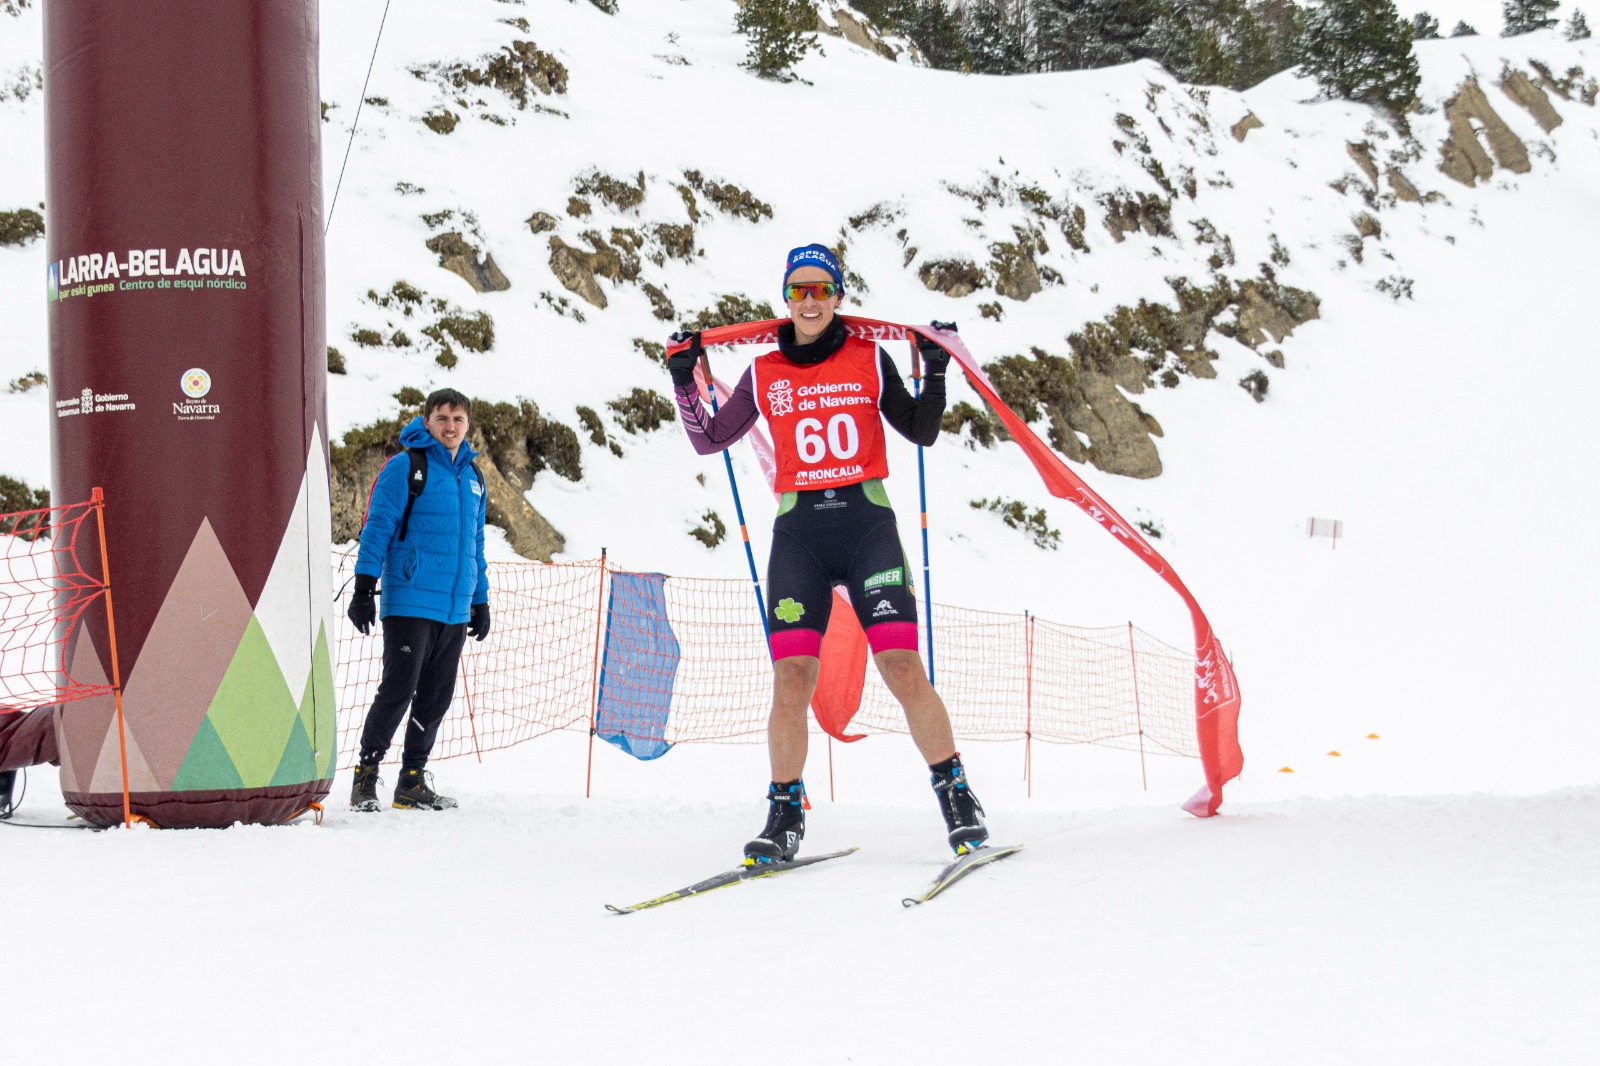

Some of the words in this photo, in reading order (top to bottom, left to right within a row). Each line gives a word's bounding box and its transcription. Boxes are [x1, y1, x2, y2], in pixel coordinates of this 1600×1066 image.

[59, 248, 246, 286] LARRA-BELAGUA
[71, 284, 86, 296] eski
[87, 283, 115, 297] gunea
[119, 280, 155, 291] Centro
[157, 277, 171, 288] de
[174, 278, 204, 291] esquí
[206, 278, 247, 289] nórdico
[797, 383, 862, 396] Gobierno
[95, 394, 129, 402] Gobierno
[798, 400, 816, 411] de
[819, 396, 872, 408] Navarra
[105, 403, 136, 411] Navarra
[172, 402, 221, 414] Navarra
[795, 413, 859, 463] 60
[808, 465, 863, 480] RONCALIA
